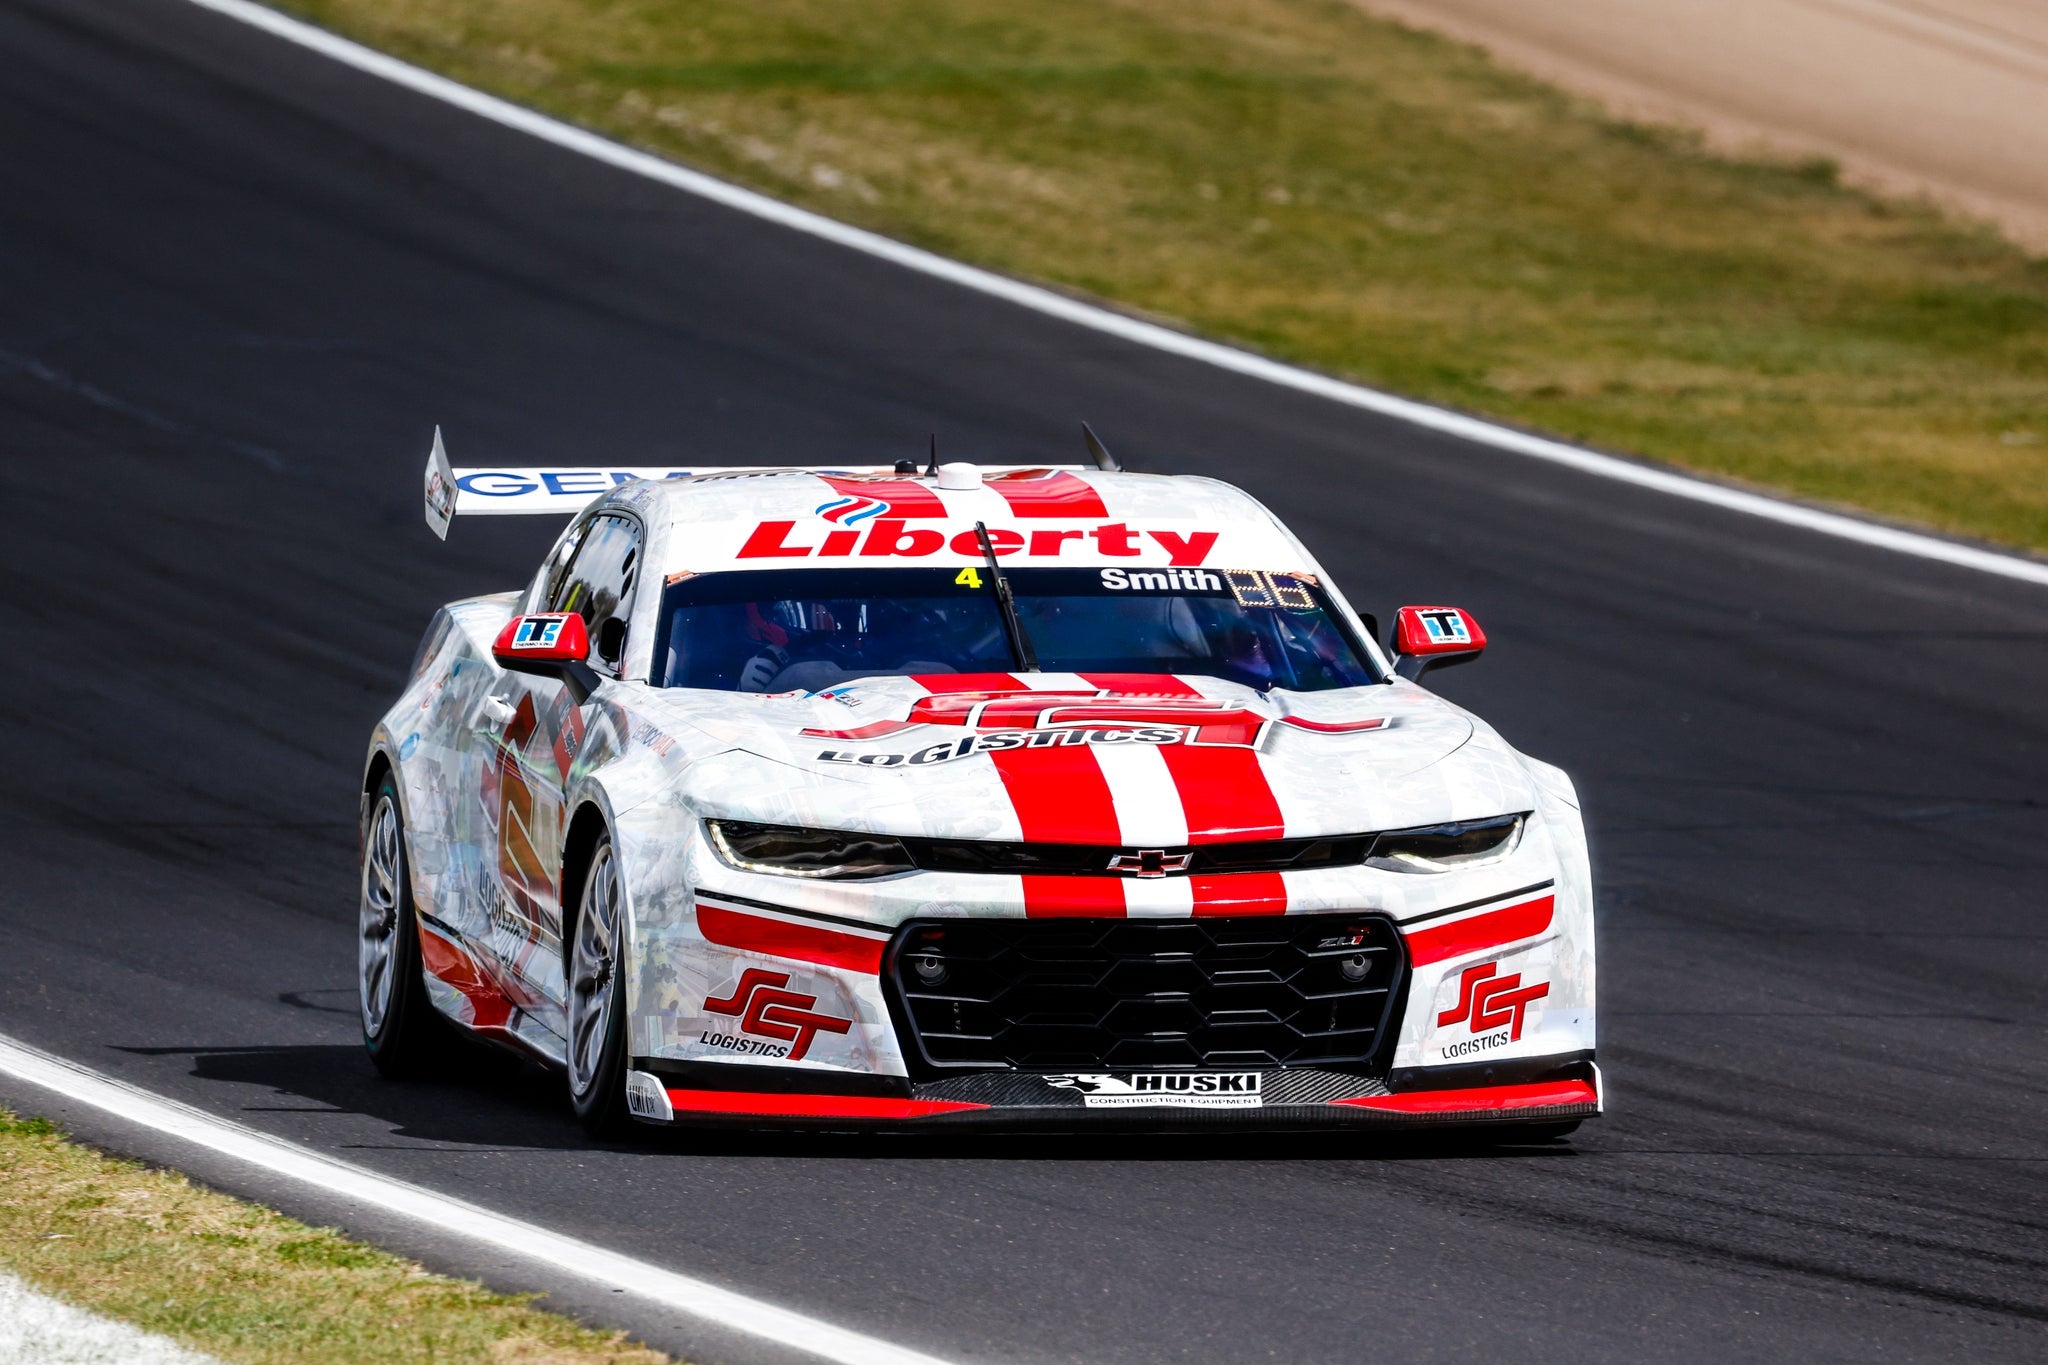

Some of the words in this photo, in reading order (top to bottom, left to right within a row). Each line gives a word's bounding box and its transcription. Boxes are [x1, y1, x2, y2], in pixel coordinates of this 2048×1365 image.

[736, 520, 1219, 566] Liberty
[955, 567, 983, 589] 4
[1101, 568, 1222, 591] Smith
[815, 729, 1184, 767] LOGISTICS
[702, 967, 853, 1061] SCT
[1437, 961, 1550, 1043] SCT
[700, 1031, 788, 1058] LOGISTICS
[1442, 1031, 1508, 1059] LOGISTICS
[1135, 1075, 1257, 1092] HUSKI
[1089, 1097, 1187, 1105] CONSTRUCTION
